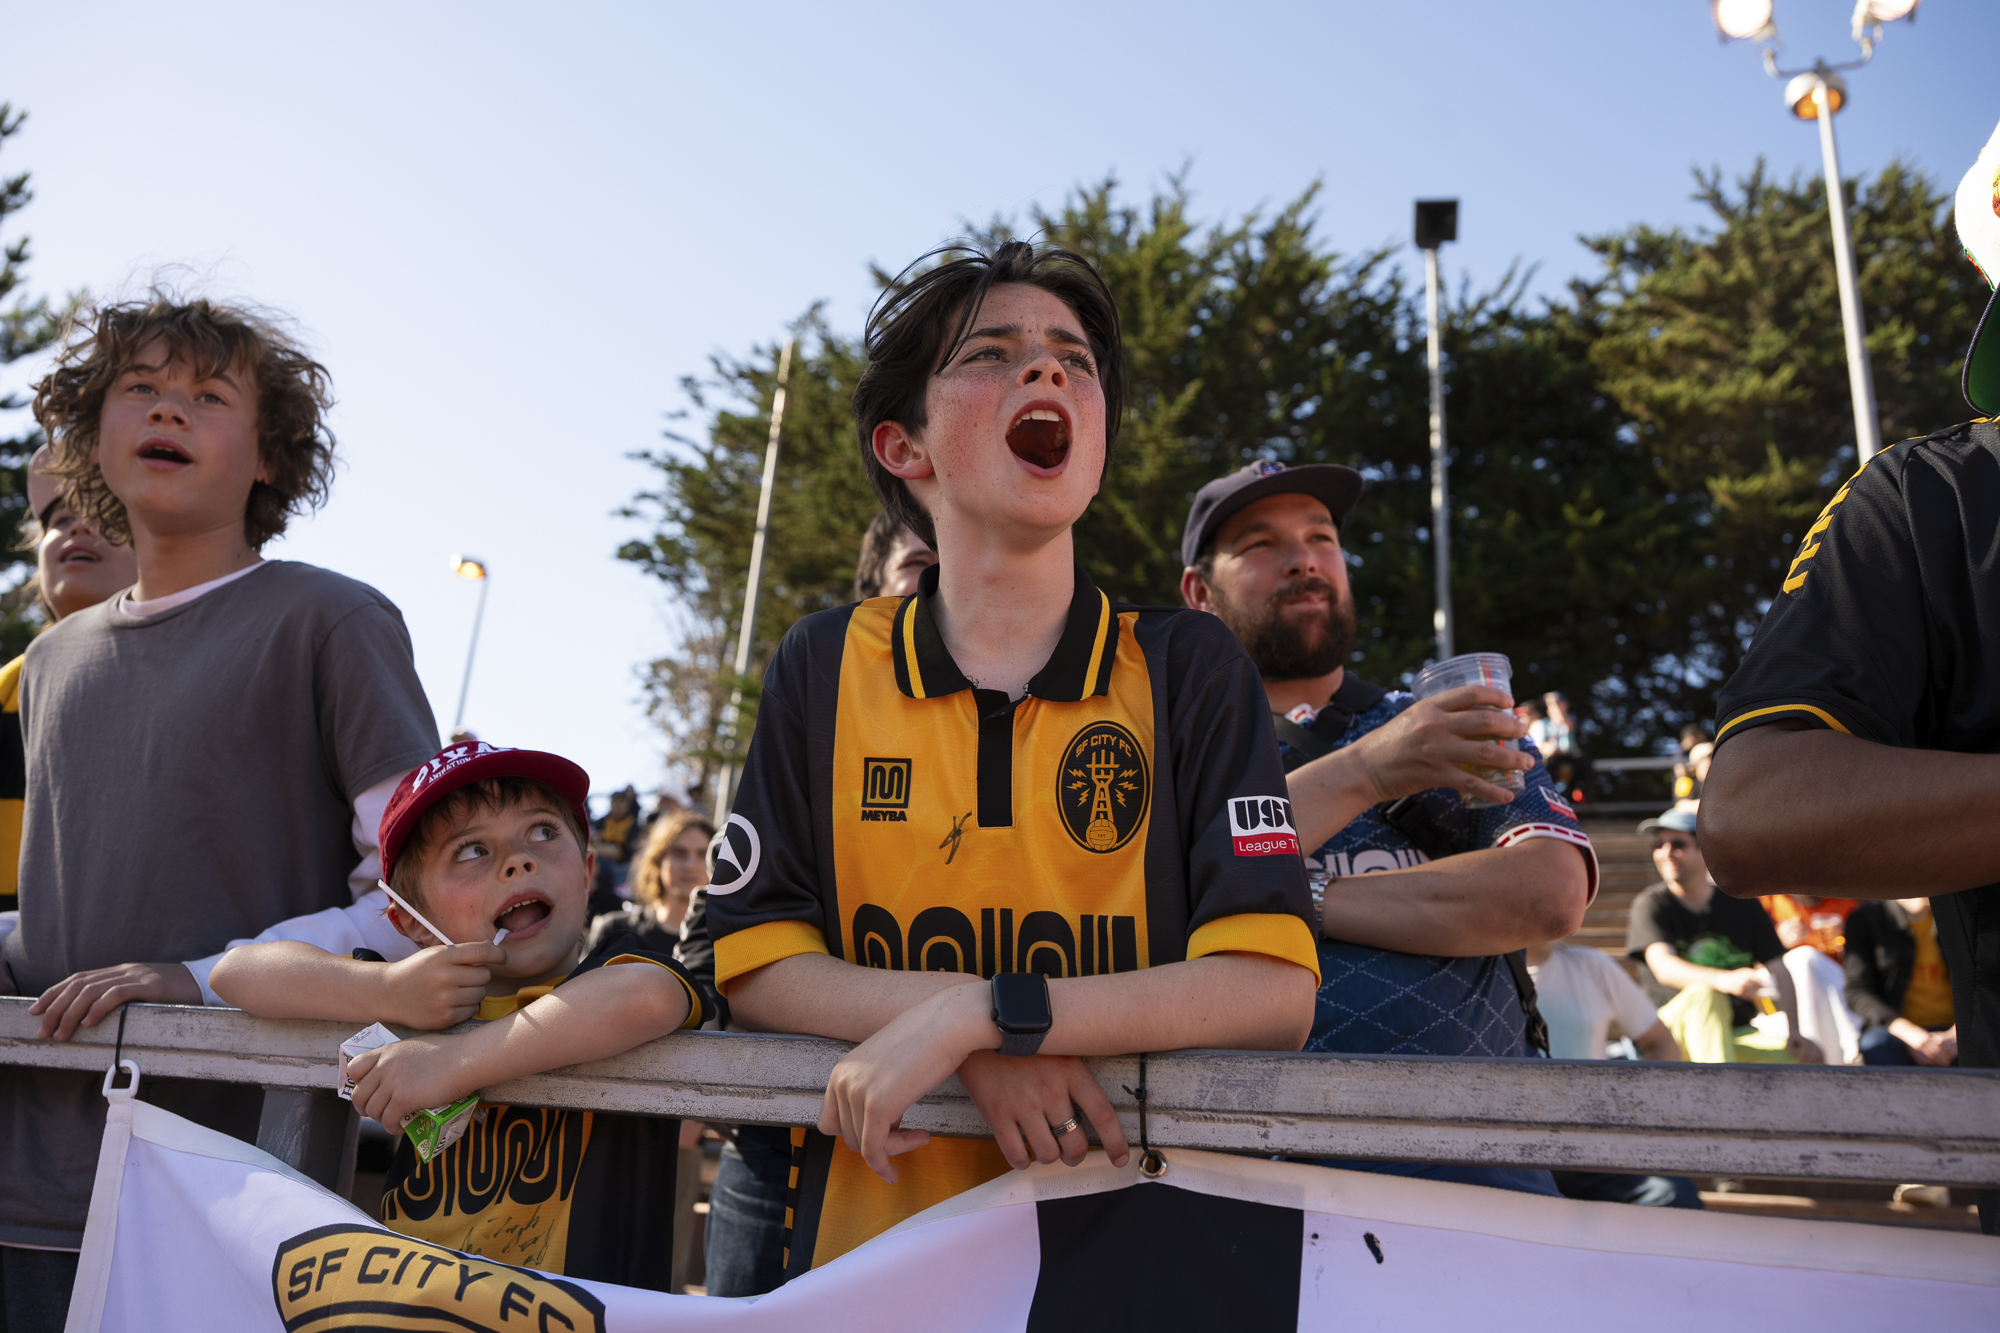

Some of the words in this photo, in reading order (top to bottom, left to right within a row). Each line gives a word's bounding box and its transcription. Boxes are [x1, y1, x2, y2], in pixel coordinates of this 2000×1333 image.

[1076, 739, 1089, 758] SF
[1090, 734, 1118, 747] CITY
[1119, 739, 1132, 758] FC
[412, 742, 513, 794] PIXA
[428, 757, 472, 784] ANIMATION
[860, 809, 908, 822] MEYBA
[1238, 839, 1288, 854] League
[287, 1247, 350, 1303] SF
[357, 1245, 494, 1302] CITY
[500, 1281, 576, 1333] FC
